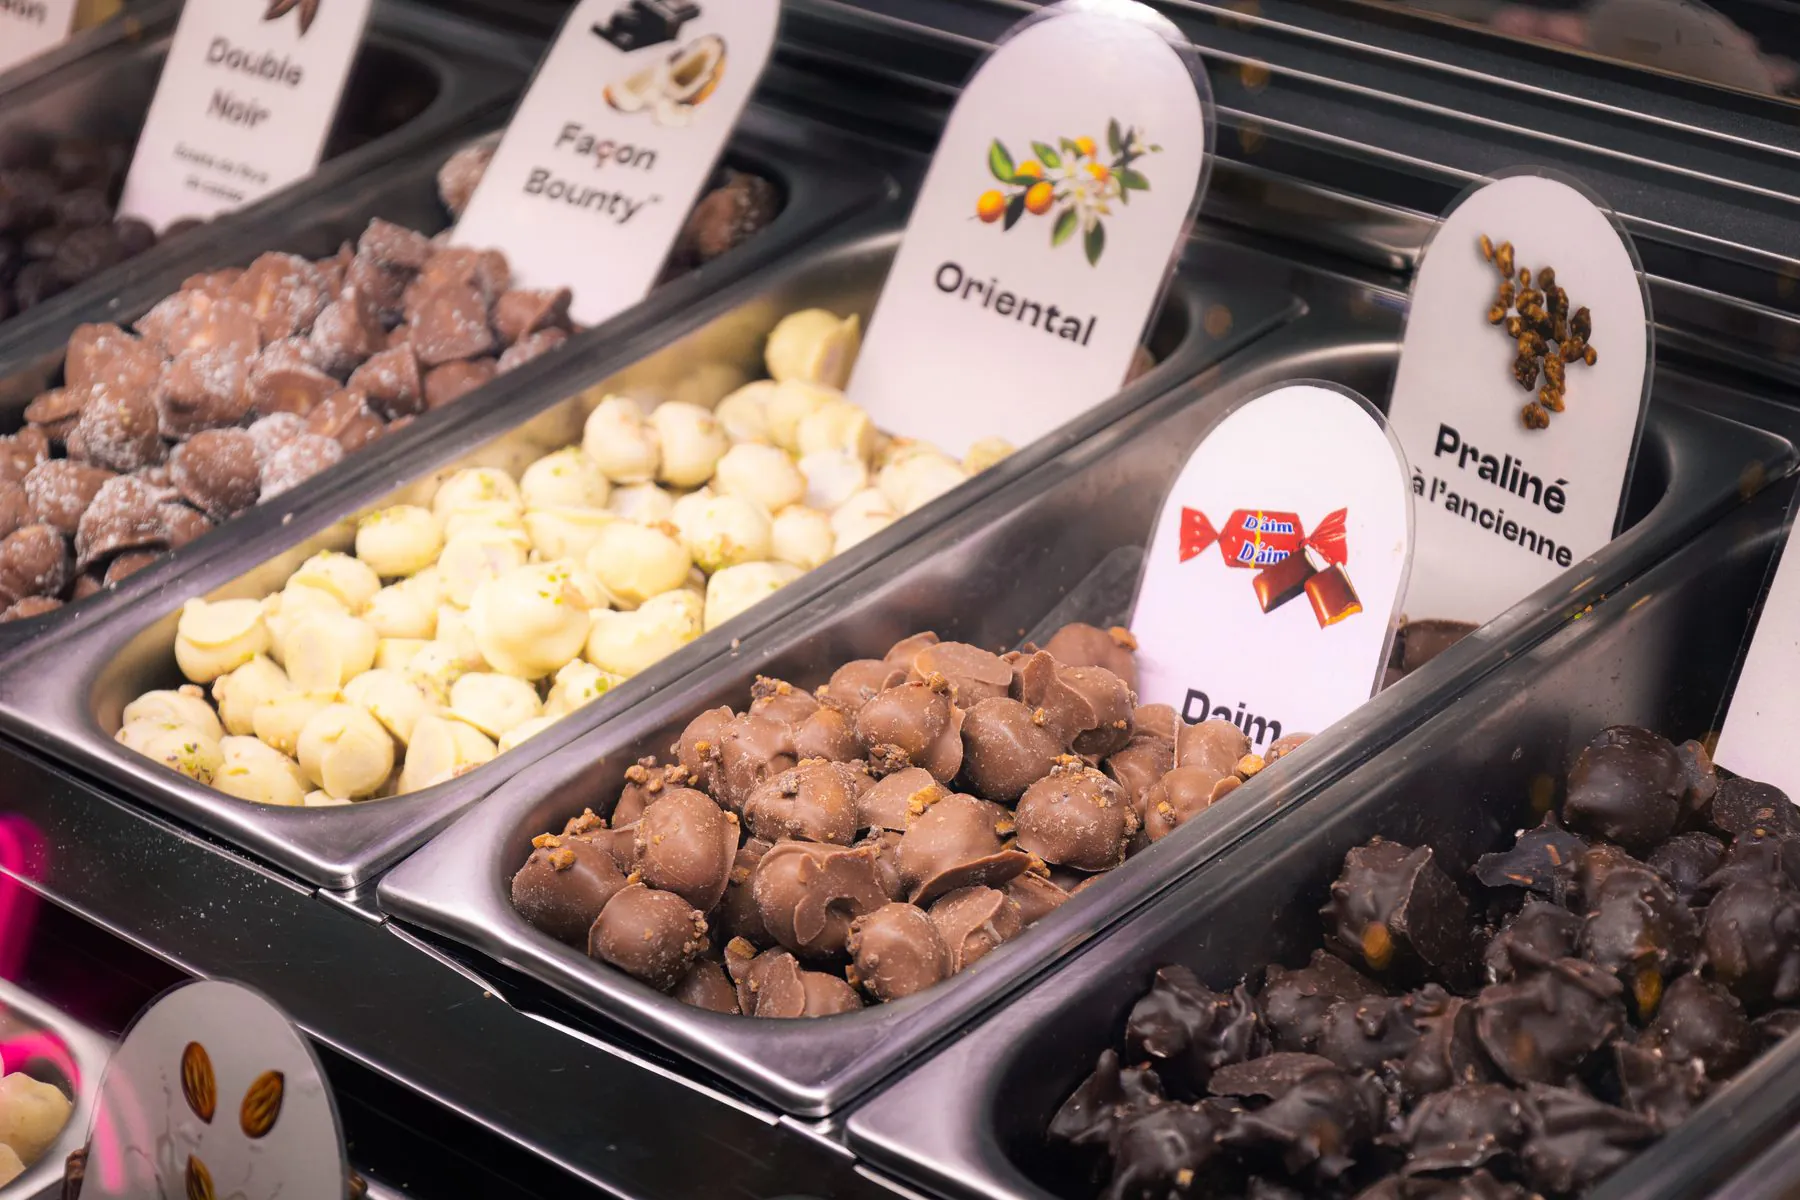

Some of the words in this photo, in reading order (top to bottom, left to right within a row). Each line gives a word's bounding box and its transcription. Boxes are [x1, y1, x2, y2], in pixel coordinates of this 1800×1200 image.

[207, 35, 303, 88] Double
[207, 89, 270, 127] Noir
[554, 122, 657, 170] Façon
[935, 262, 1097, 346] Oriental
[1412, 466, 1425, 496] à
[1434, 422, 1570, 514] Praliné
